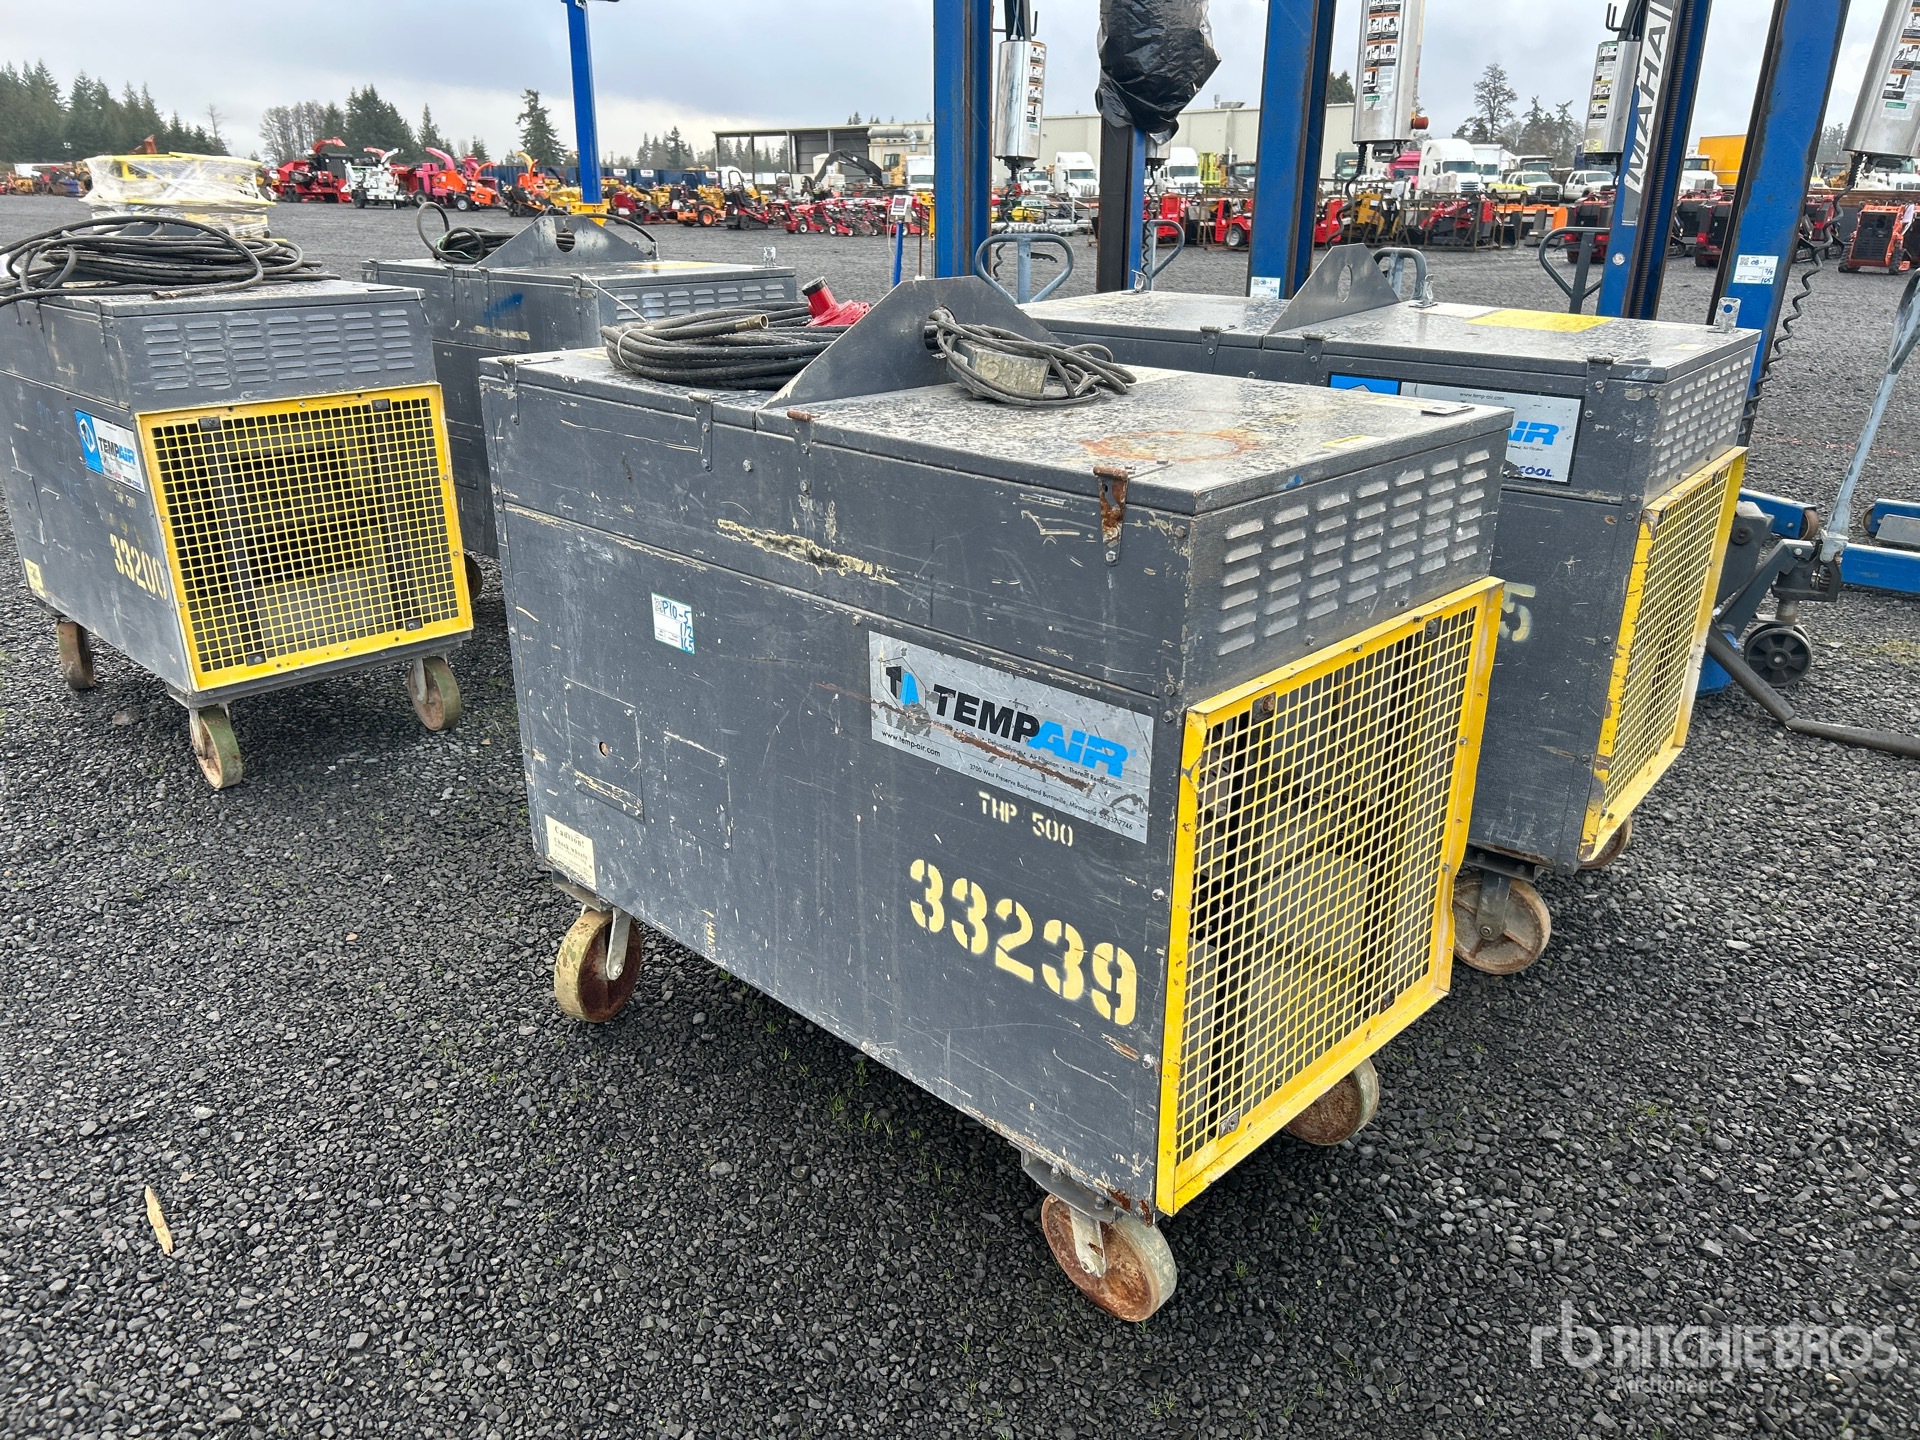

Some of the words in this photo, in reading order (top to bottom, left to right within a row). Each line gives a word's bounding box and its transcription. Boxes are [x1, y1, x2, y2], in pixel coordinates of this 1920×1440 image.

[1625, 25, 1667, 188] MAHA
[110, 533, 167, 600] 33200
[881, 729, 941, 758] www.temp-air.com
[933, 683, 1129, 779] TEMPAIR
[983, 769, 995, 778] West
[1016, 781, 1042, 796] Boulevard
[554, 825, 585, 848] Caution!
[978, 790, 1018, 824] THP
[1031, 811, 1074, 847] 500
[909, 858, 1137, 1026] 33239
